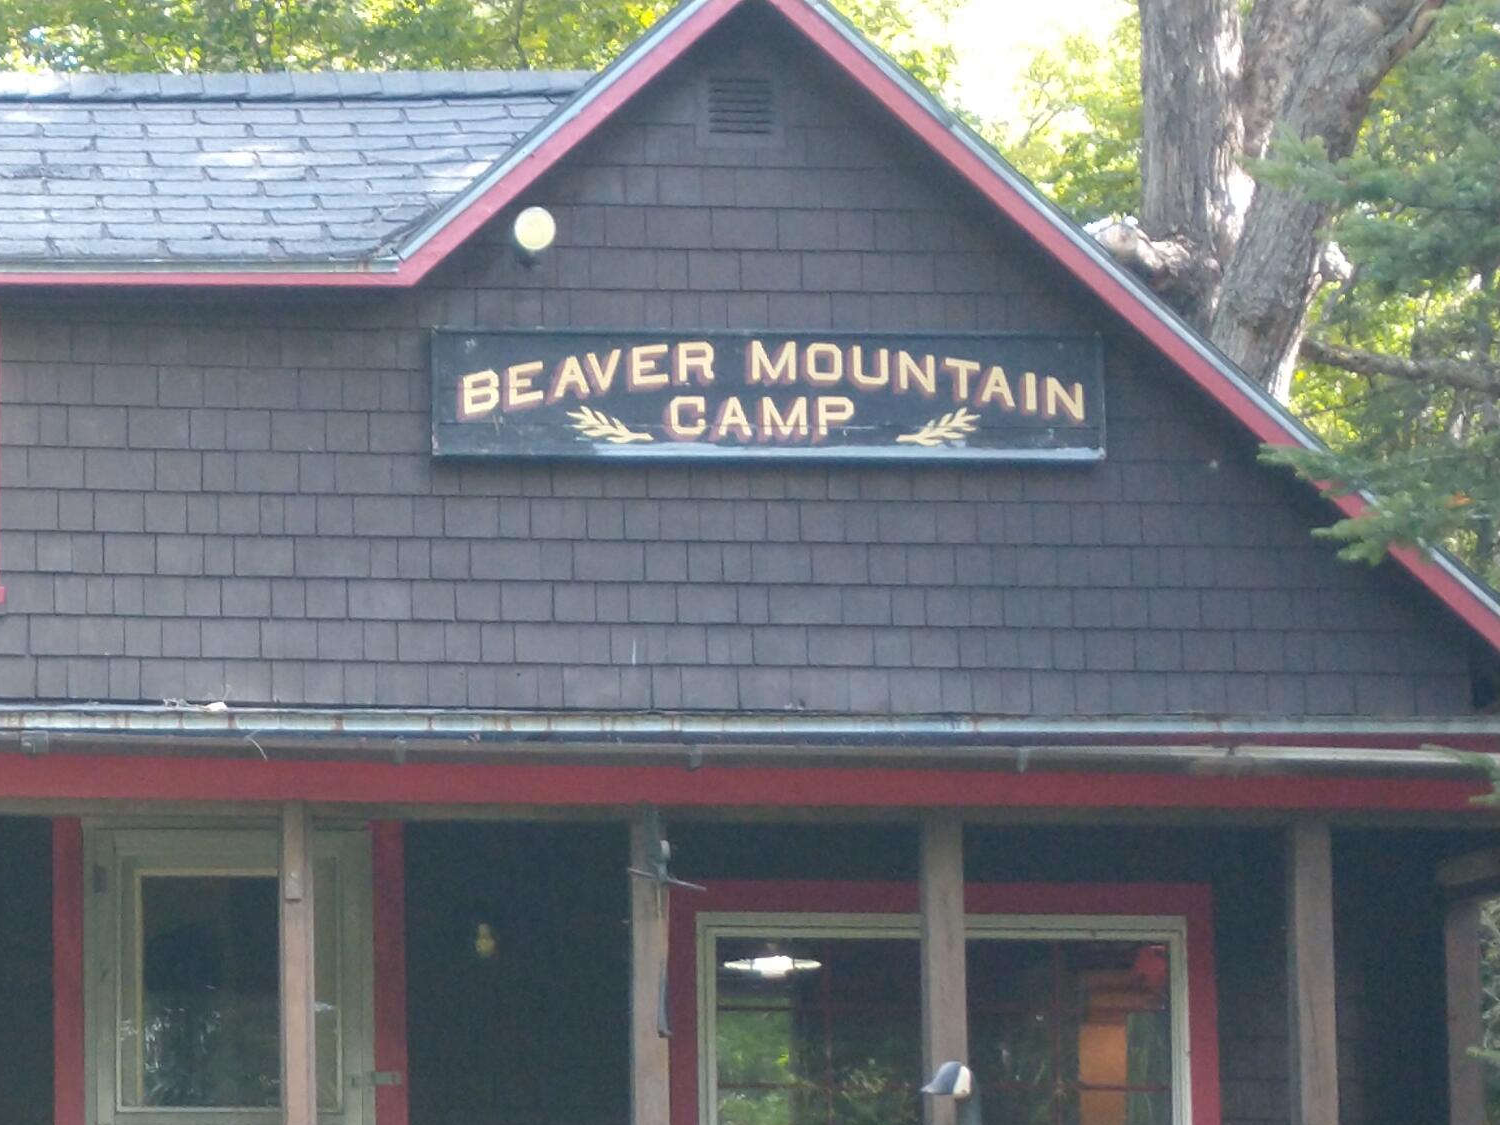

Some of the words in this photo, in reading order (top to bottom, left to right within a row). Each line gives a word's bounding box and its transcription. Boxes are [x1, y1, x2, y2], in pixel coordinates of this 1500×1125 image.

[459, 340, 715, 417] BEAVER
[748, 339, 1086, 422] MOUNTAIN
[666, 395, 855, 438] CAMP
